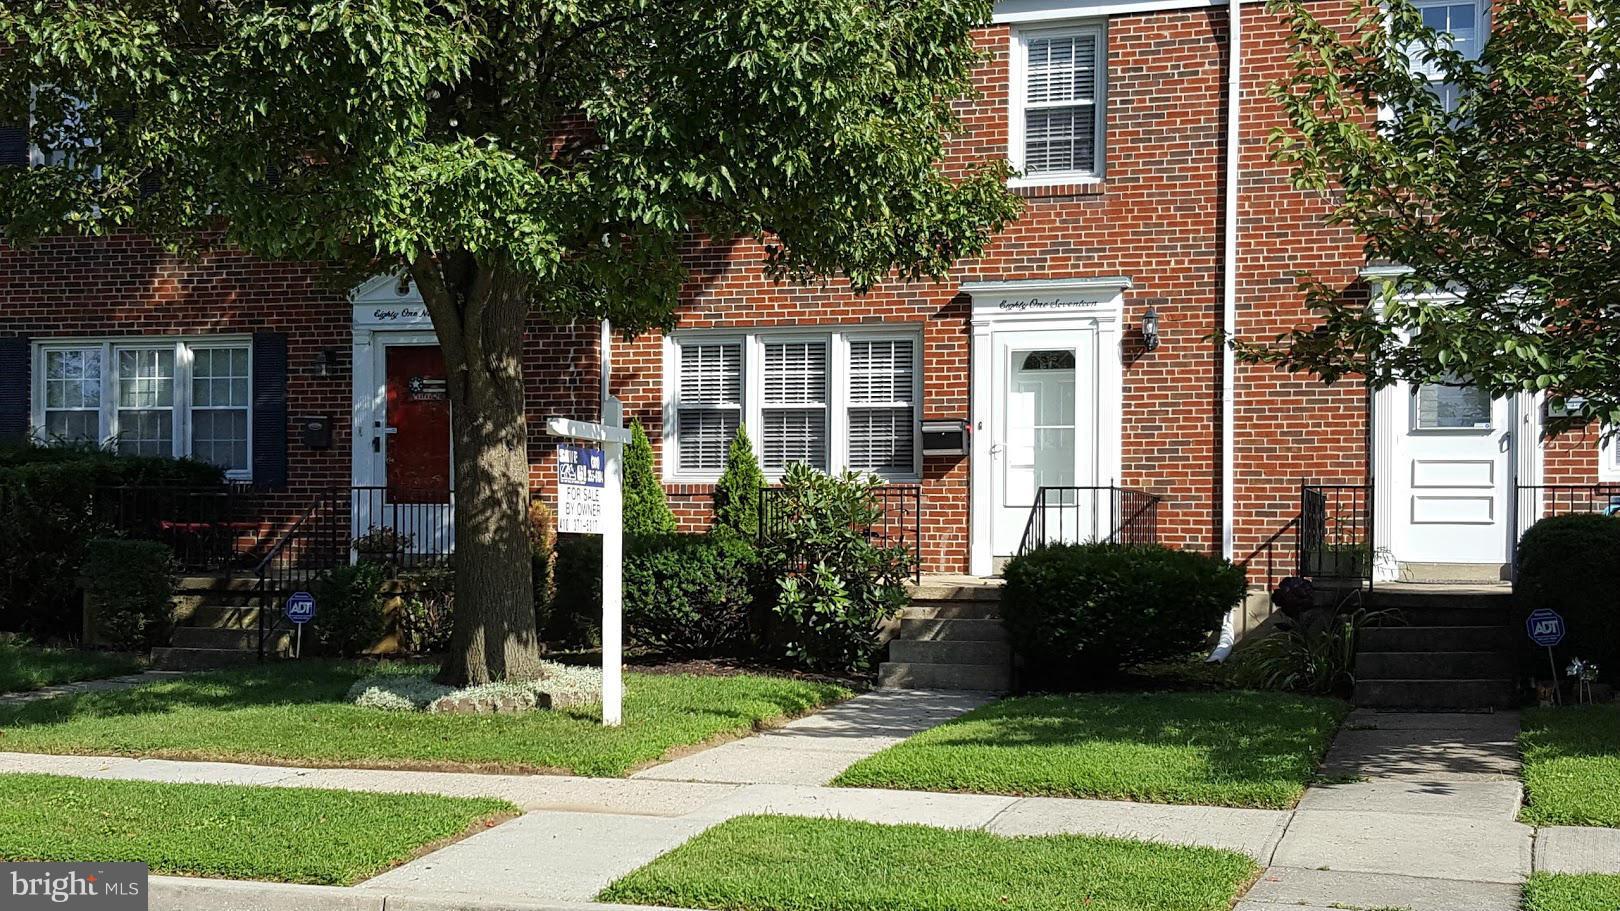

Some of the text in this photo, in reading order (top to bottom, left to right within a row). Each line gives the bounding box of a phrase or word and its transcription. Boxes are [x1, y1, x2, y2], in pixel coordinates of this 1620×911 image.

[1000, 298, 1097, 310] Eighty One Seventeen
[374, 309, 399, 321] Eighty
[401, 307, 418, 318] One
[567, 486, 600, 502] FOR SALE
[566, 501, 601, 517] BY OWNER
[290, 601, 313, 614] ADT
[1534, 620, 1558, 635] ADT
